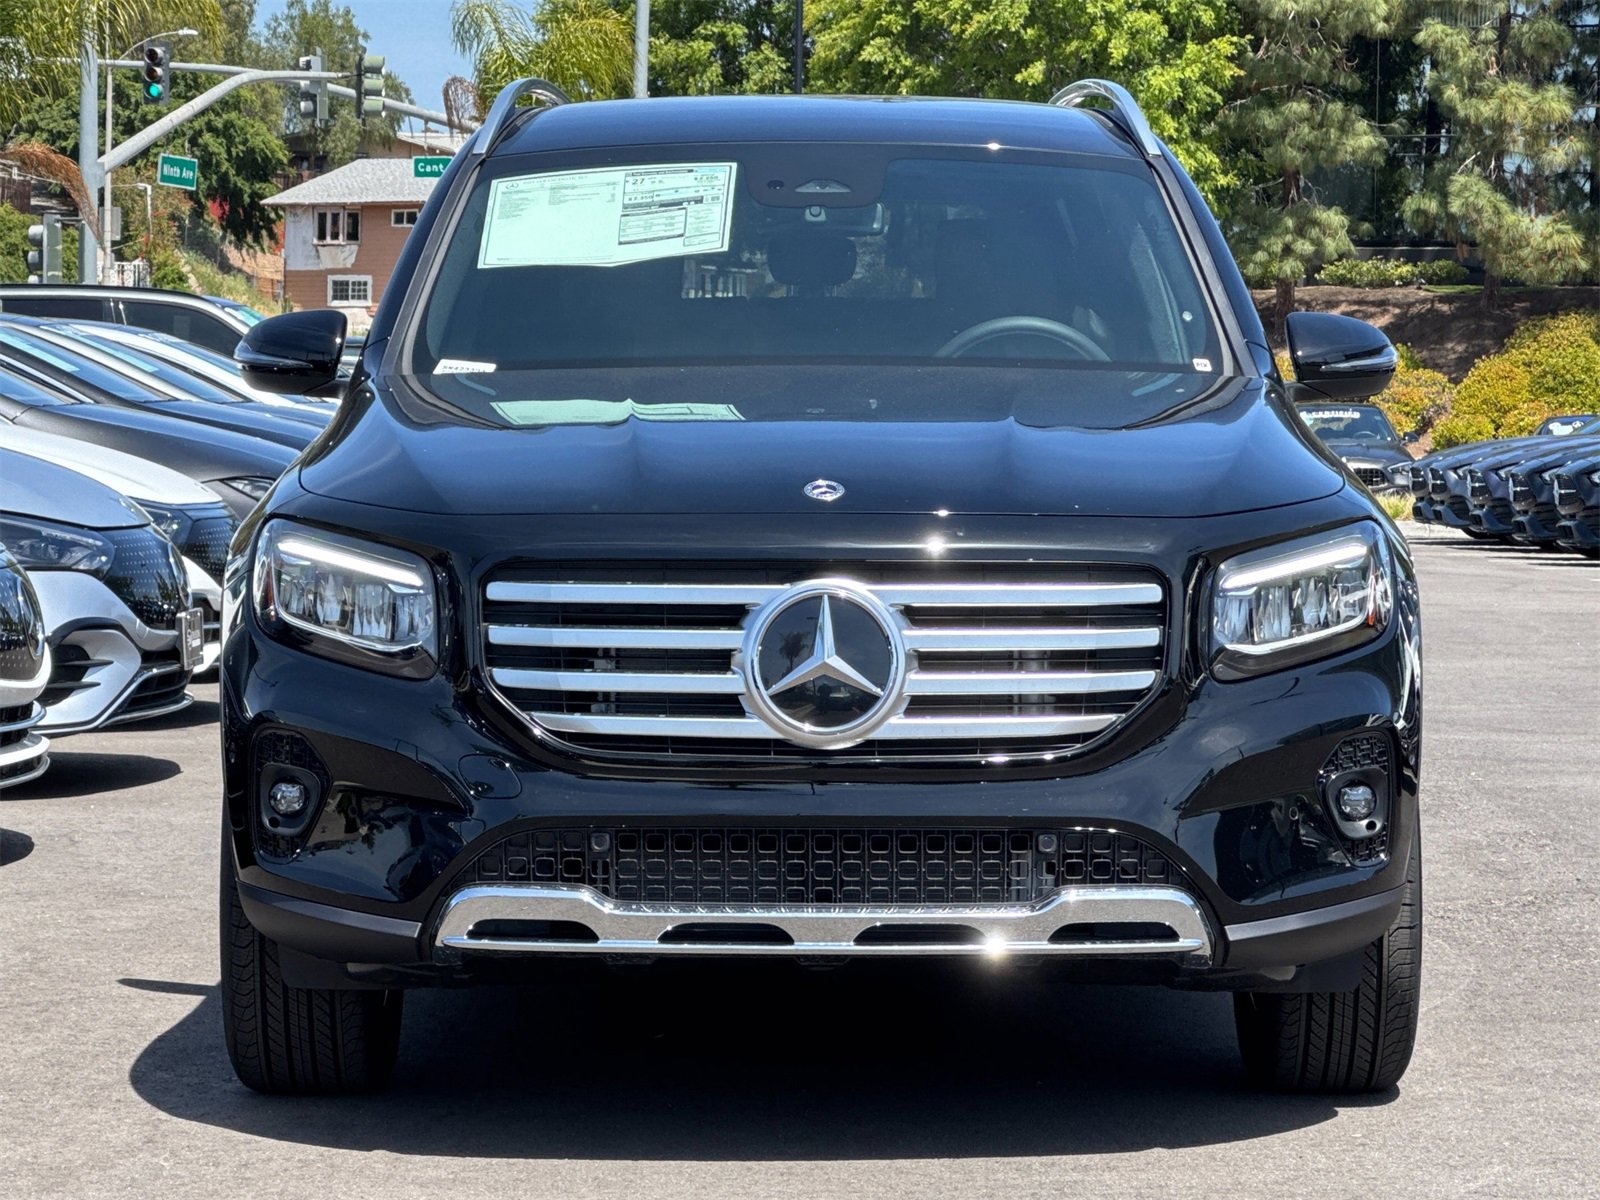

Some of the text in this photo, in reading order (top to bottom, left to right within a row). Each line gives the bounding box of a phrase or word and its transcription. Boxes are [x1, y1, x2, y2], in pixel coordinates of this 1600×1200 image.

[163, 164, 194, 180] Ninth Ave
[632, 178, 645, 186] 27
